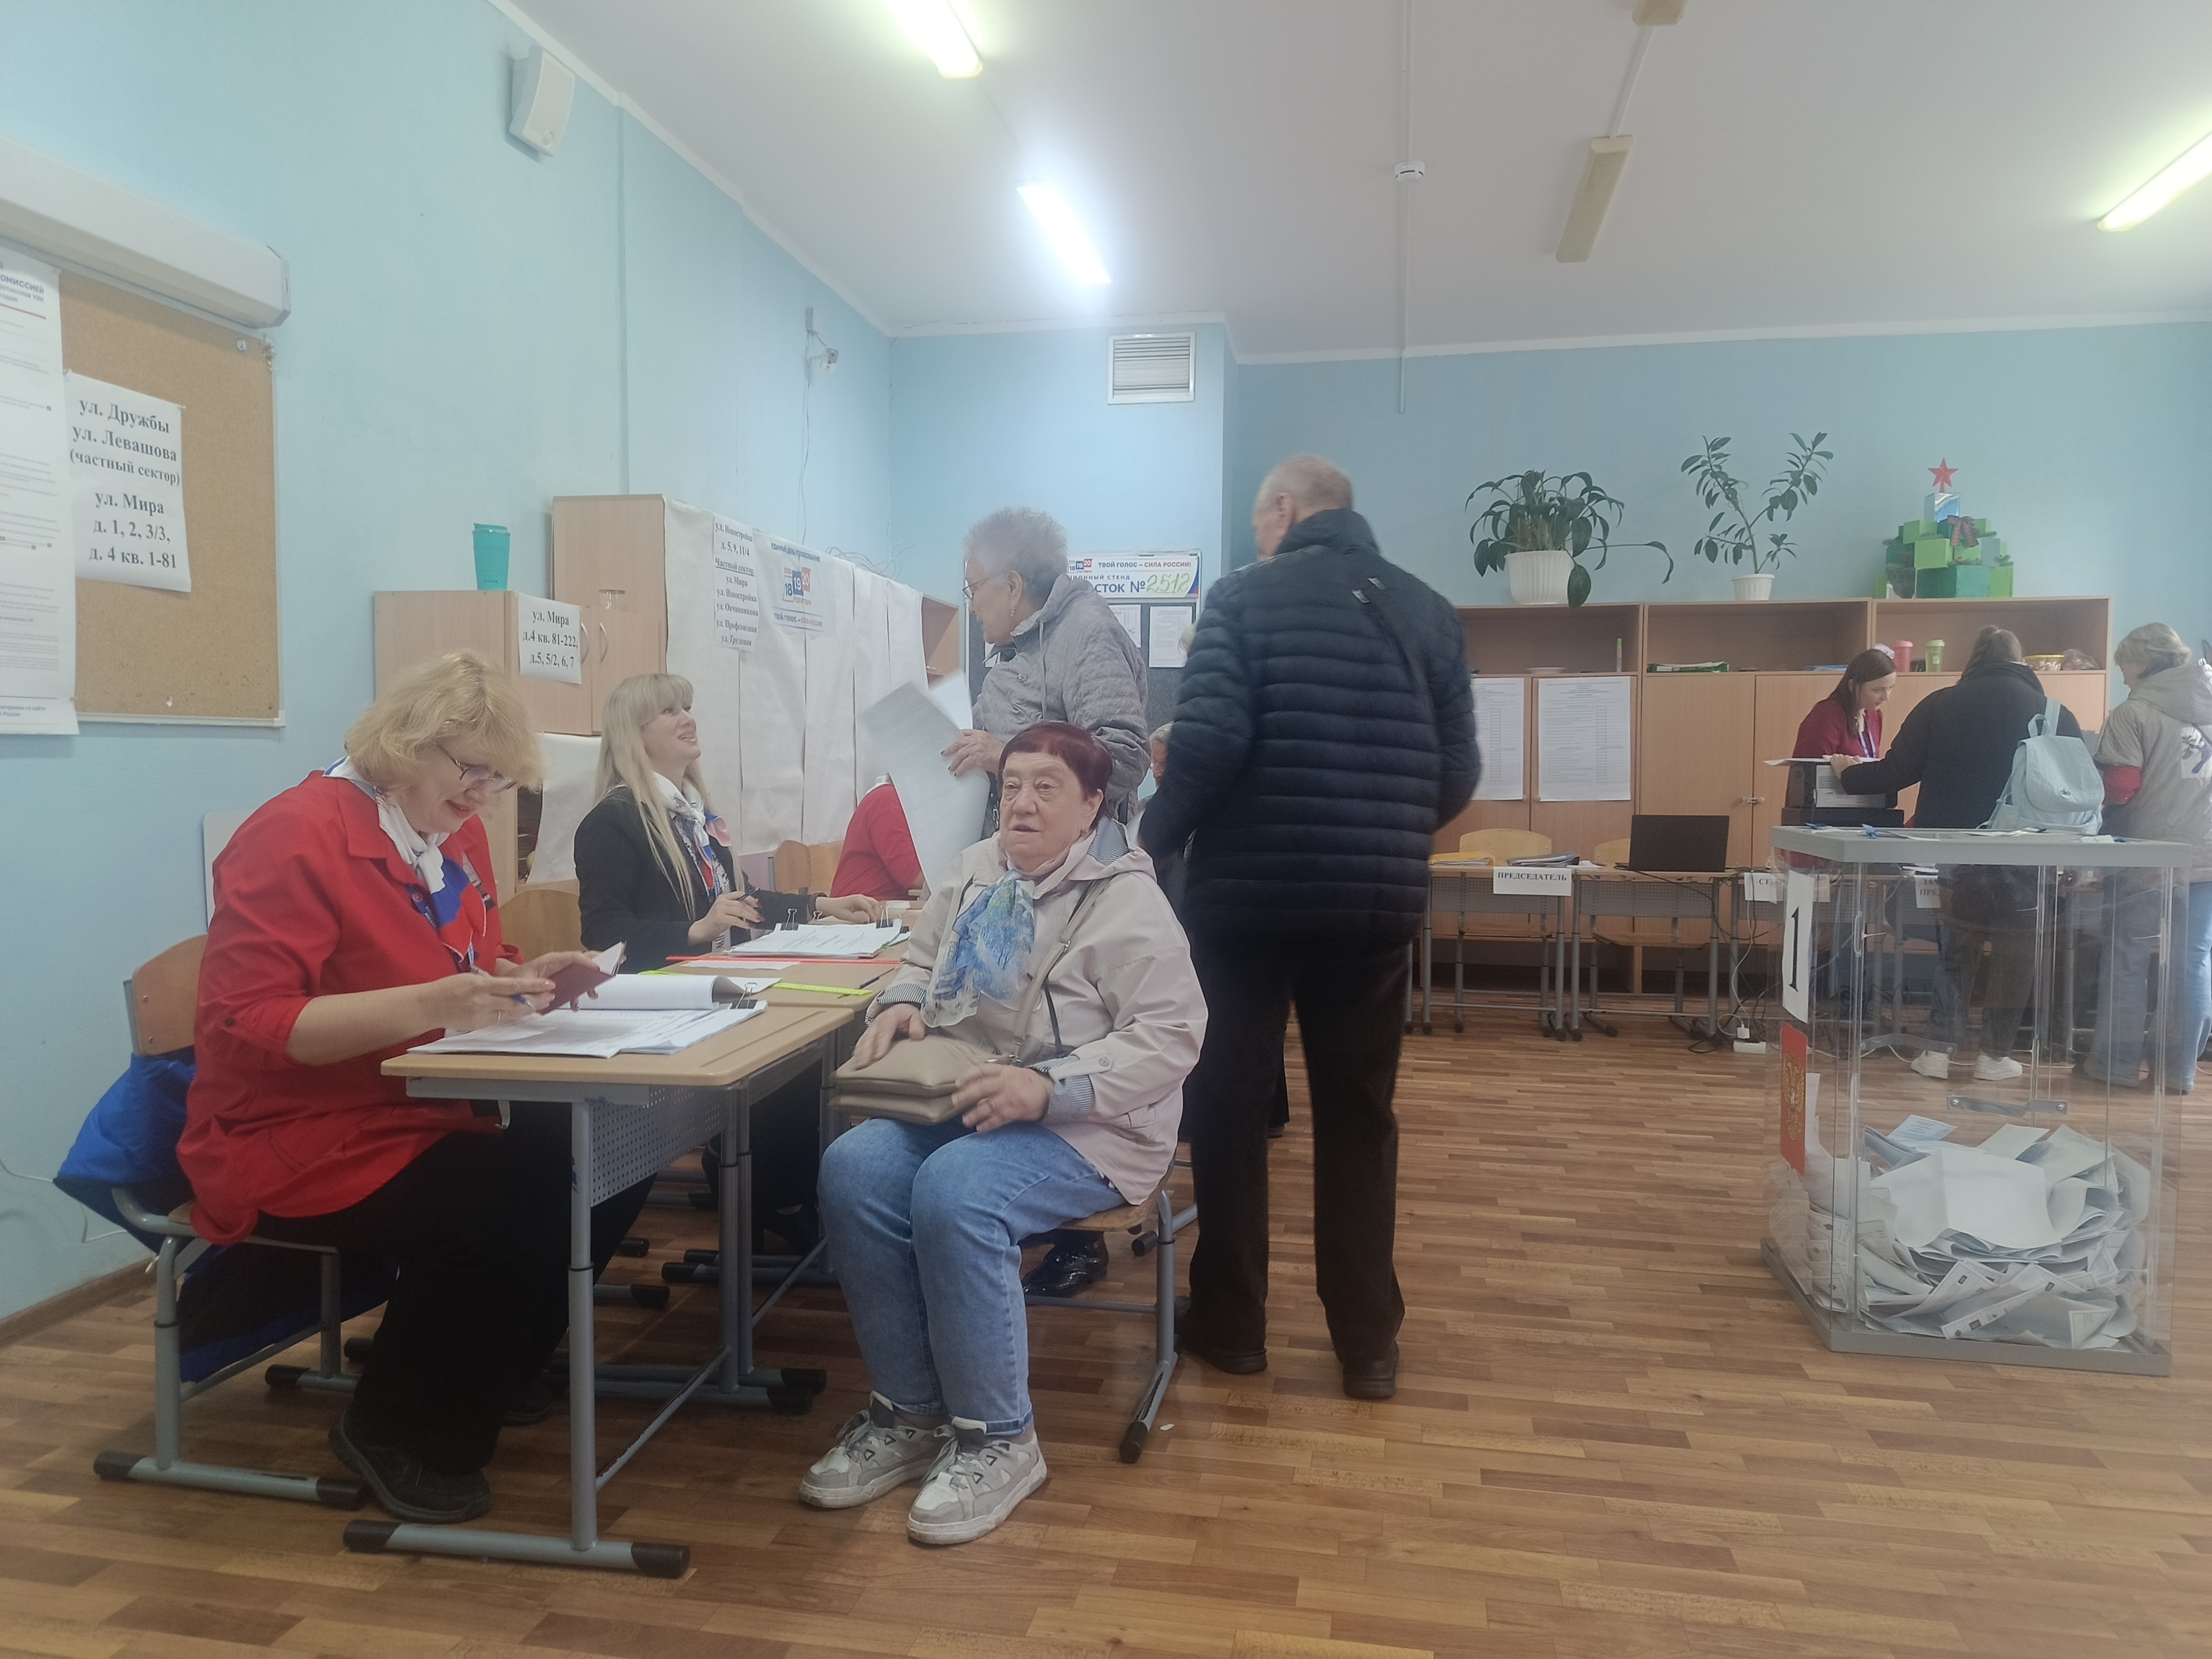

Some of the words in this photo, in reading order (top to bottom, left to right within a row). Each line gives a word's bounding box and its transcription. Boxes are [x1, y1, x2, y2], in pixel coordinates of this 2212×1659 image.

[0, 275, 44, 294] ОМИССИЕЙ
[79, 400, 103, 416] ул.
[108, 404, 169, 434] Дружбы
[72, 426, 96, 442] ул.
[102, 430, 177, 462] Левашова
[70, 448, 134, 474] (частный
[138, 466, 180, 486] сектор)
[95, 493, 118, 508] ул.
[123, 493, 164, 517] Мира
[93, 521, 106, 533] д.
[113, 520, 124, 539] 1,
[129, 522, 142, 541] 2,
[146, 524, 171, 544] 3/3,
[715, 522, 724, 532] ул.
[725, 525, 753, 542] Новостройка
[89, 548, 103, 561] д.
[108, 546, 116, 561] 4
[121, 552, 144, 565] кв.
[149, 551, 177, 569] 1-81
[715, 557, 737, 570] Частный
[734, 576, 748, 588] Мира
[793, 576, 802, 590] 19
[801, 572, 809, 586] 20
[716, 589, 725, 597] ул.
[726, 589, 757, 602] Новостройка
[785, 583, 792, 596] 18
[1094, 584, 1125, 593] СТОК
[725, 603, 758, 616] Овчинникова
[532, 612, 545, 623] ул.
[547, 611, 569, 628] Мира
[725, 619, 757, 633] Профсоюзная
[523, 630, 535, 642] д.4
[538, 634, 550, 643] кв.
[552, 633, 578, 650] 81-222,
[730, 635, 751, 646] Трудовая
[530, 652, 544, 666] д.5,
[546, 653, 560, 668] 5/2,
[561, 655, 569, 670] 6,
[570, 656, 574, 668] 7
[1498, 872, 1567, 881] ПРЕДСЕДАТЕЛЬ
[1789, 906, 1799, 993] 1
